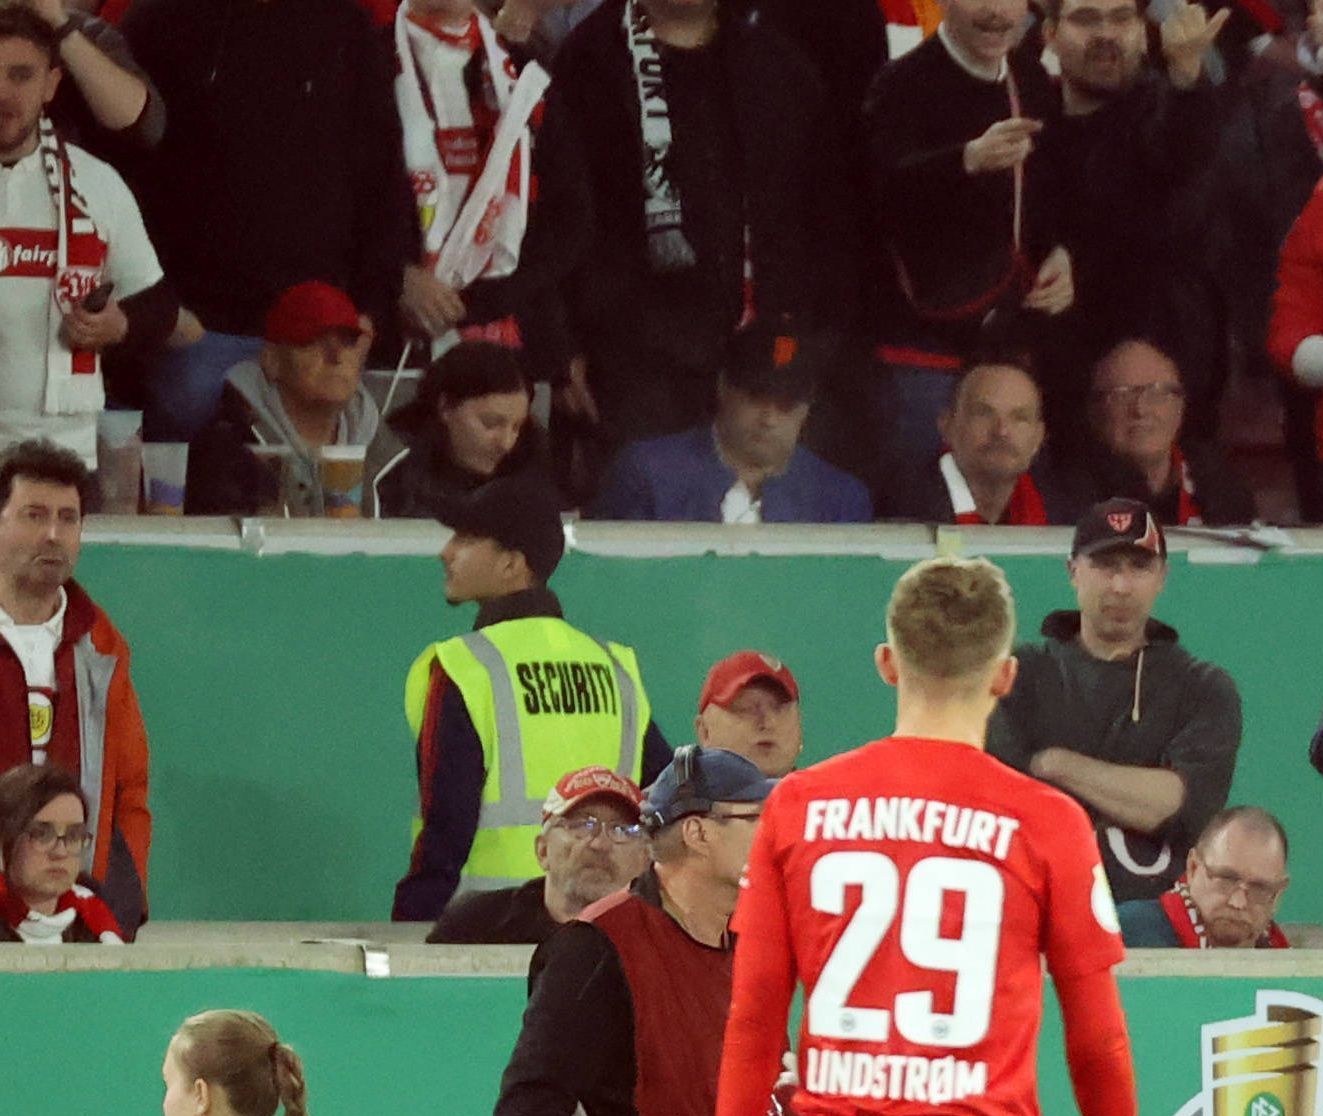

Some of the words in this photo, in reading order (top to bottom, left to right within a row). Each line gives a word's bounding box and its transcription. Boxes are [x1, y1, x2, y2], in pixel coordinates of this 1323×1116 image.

[515, 661, 617, 717] SECURITY
[803, 797, 1021, 862] FRANKFURT
[807, 851, 1007, 1048] 29
